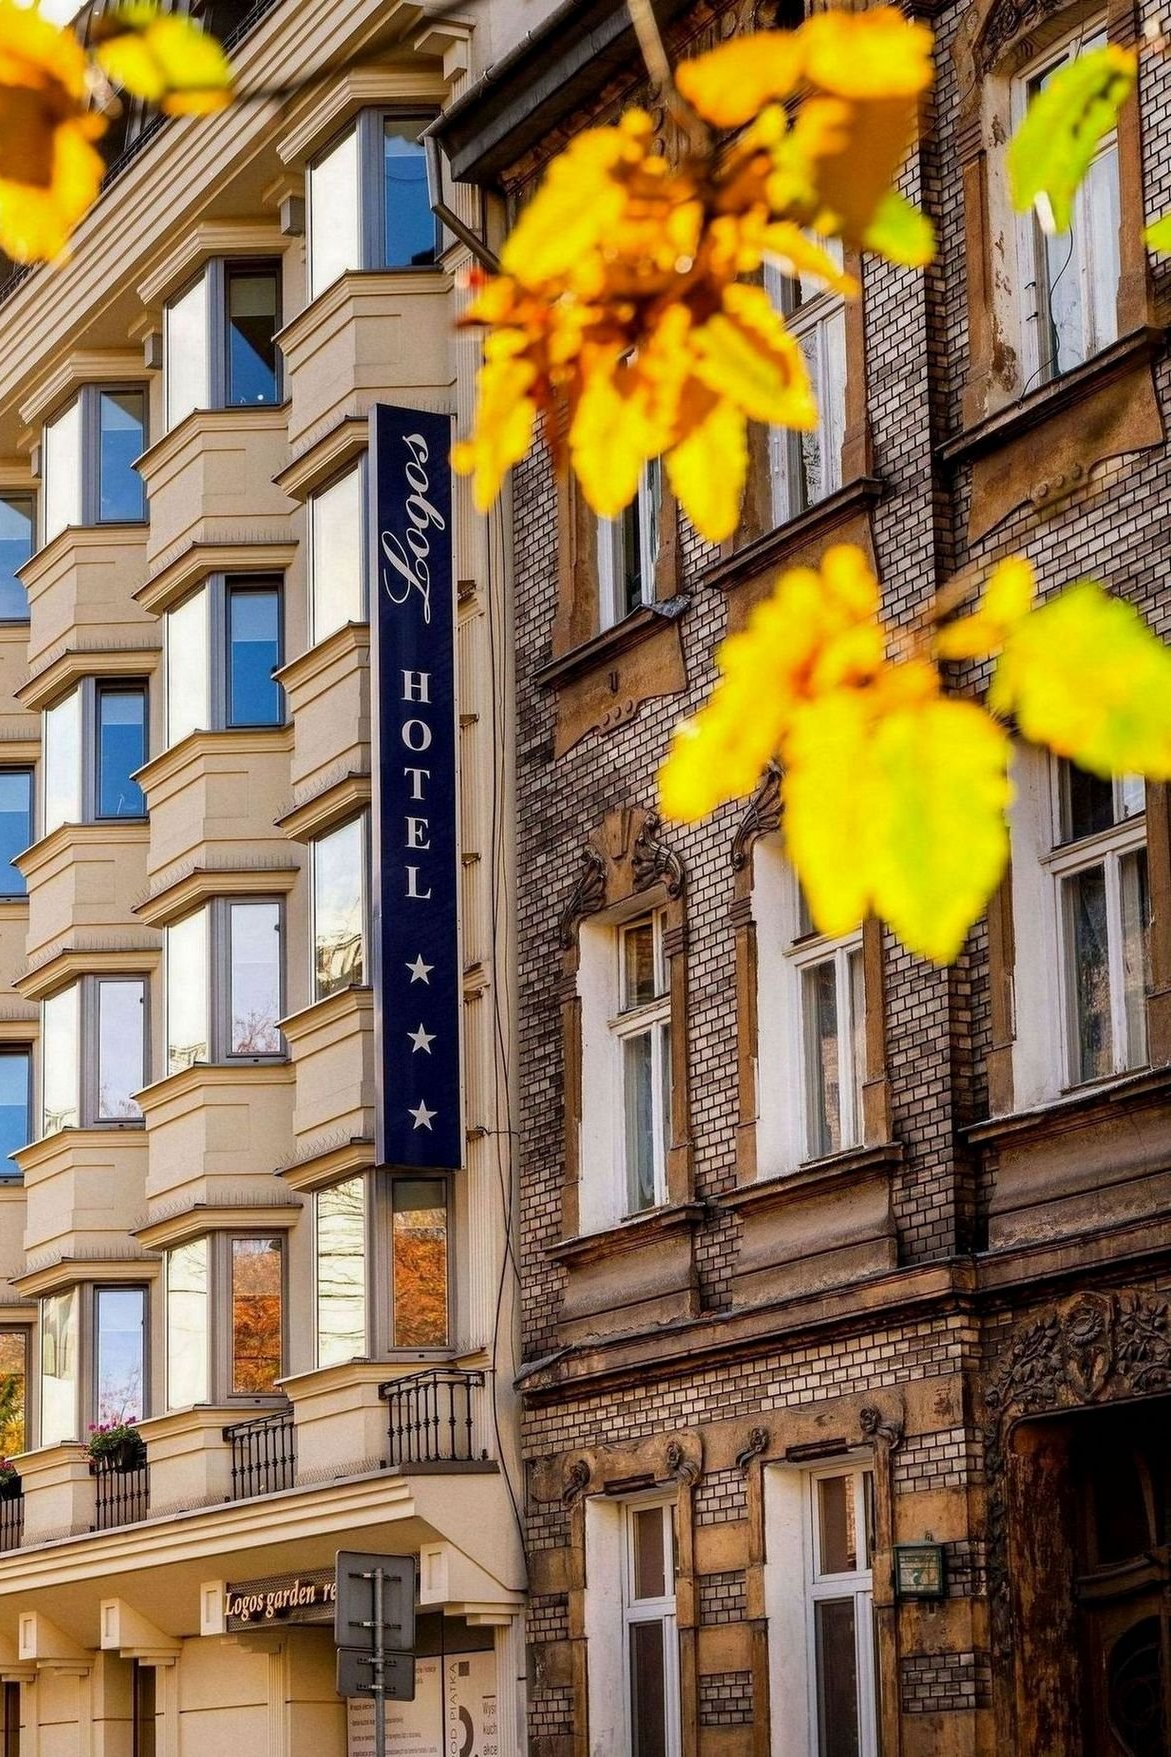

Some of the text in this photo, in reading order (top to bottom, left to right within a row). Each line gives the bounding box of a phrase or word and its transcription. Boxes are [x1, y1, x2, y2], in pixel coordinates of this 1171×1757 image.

[381, 433, 446, 899] Logos HOTEL
[224, 1579, 337, 1622] Logos garden re
